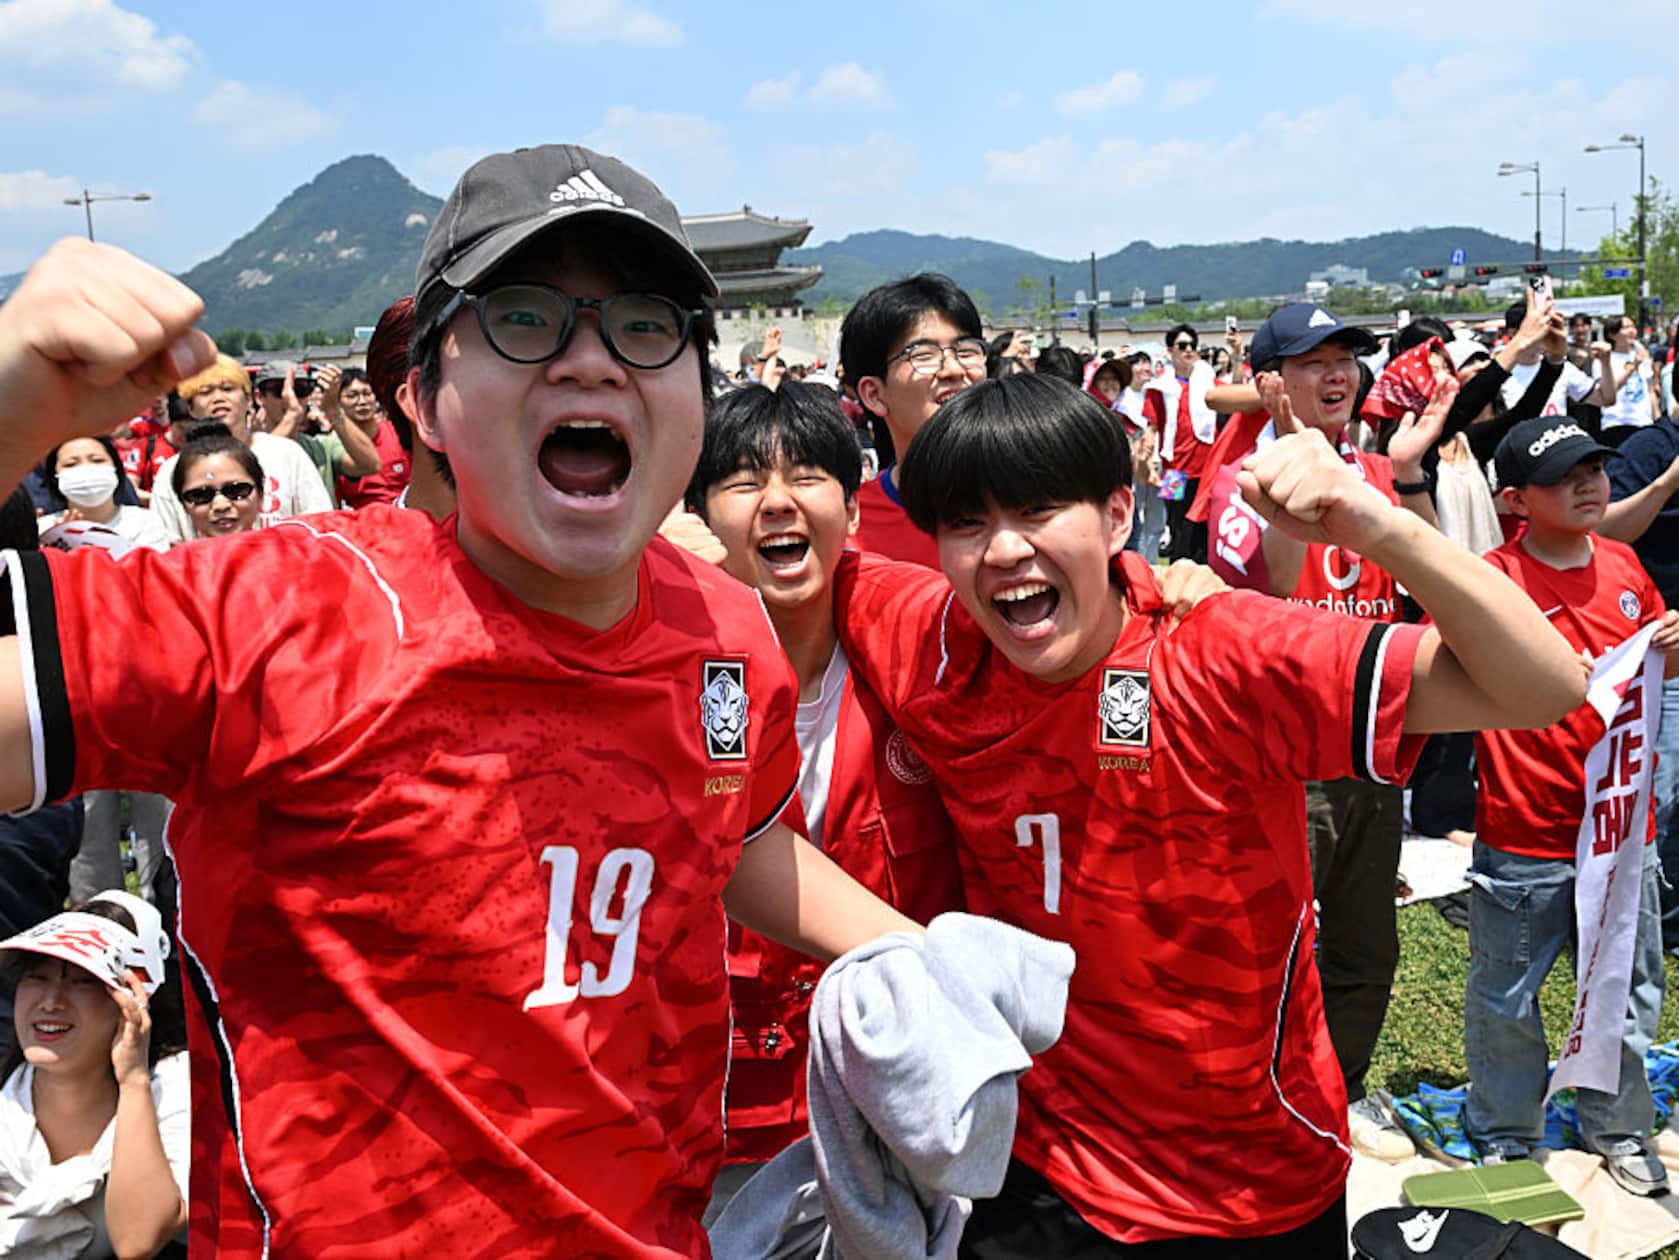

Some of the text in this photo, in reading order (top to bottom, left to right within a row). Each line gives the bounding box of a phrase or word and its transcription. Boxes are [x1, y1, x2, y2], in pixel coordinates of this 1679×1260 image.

[1286, 592, 1396, 617] dafon
[1014, 812, 1063, 915] 7
[522, 845, 655, 1012] 19
